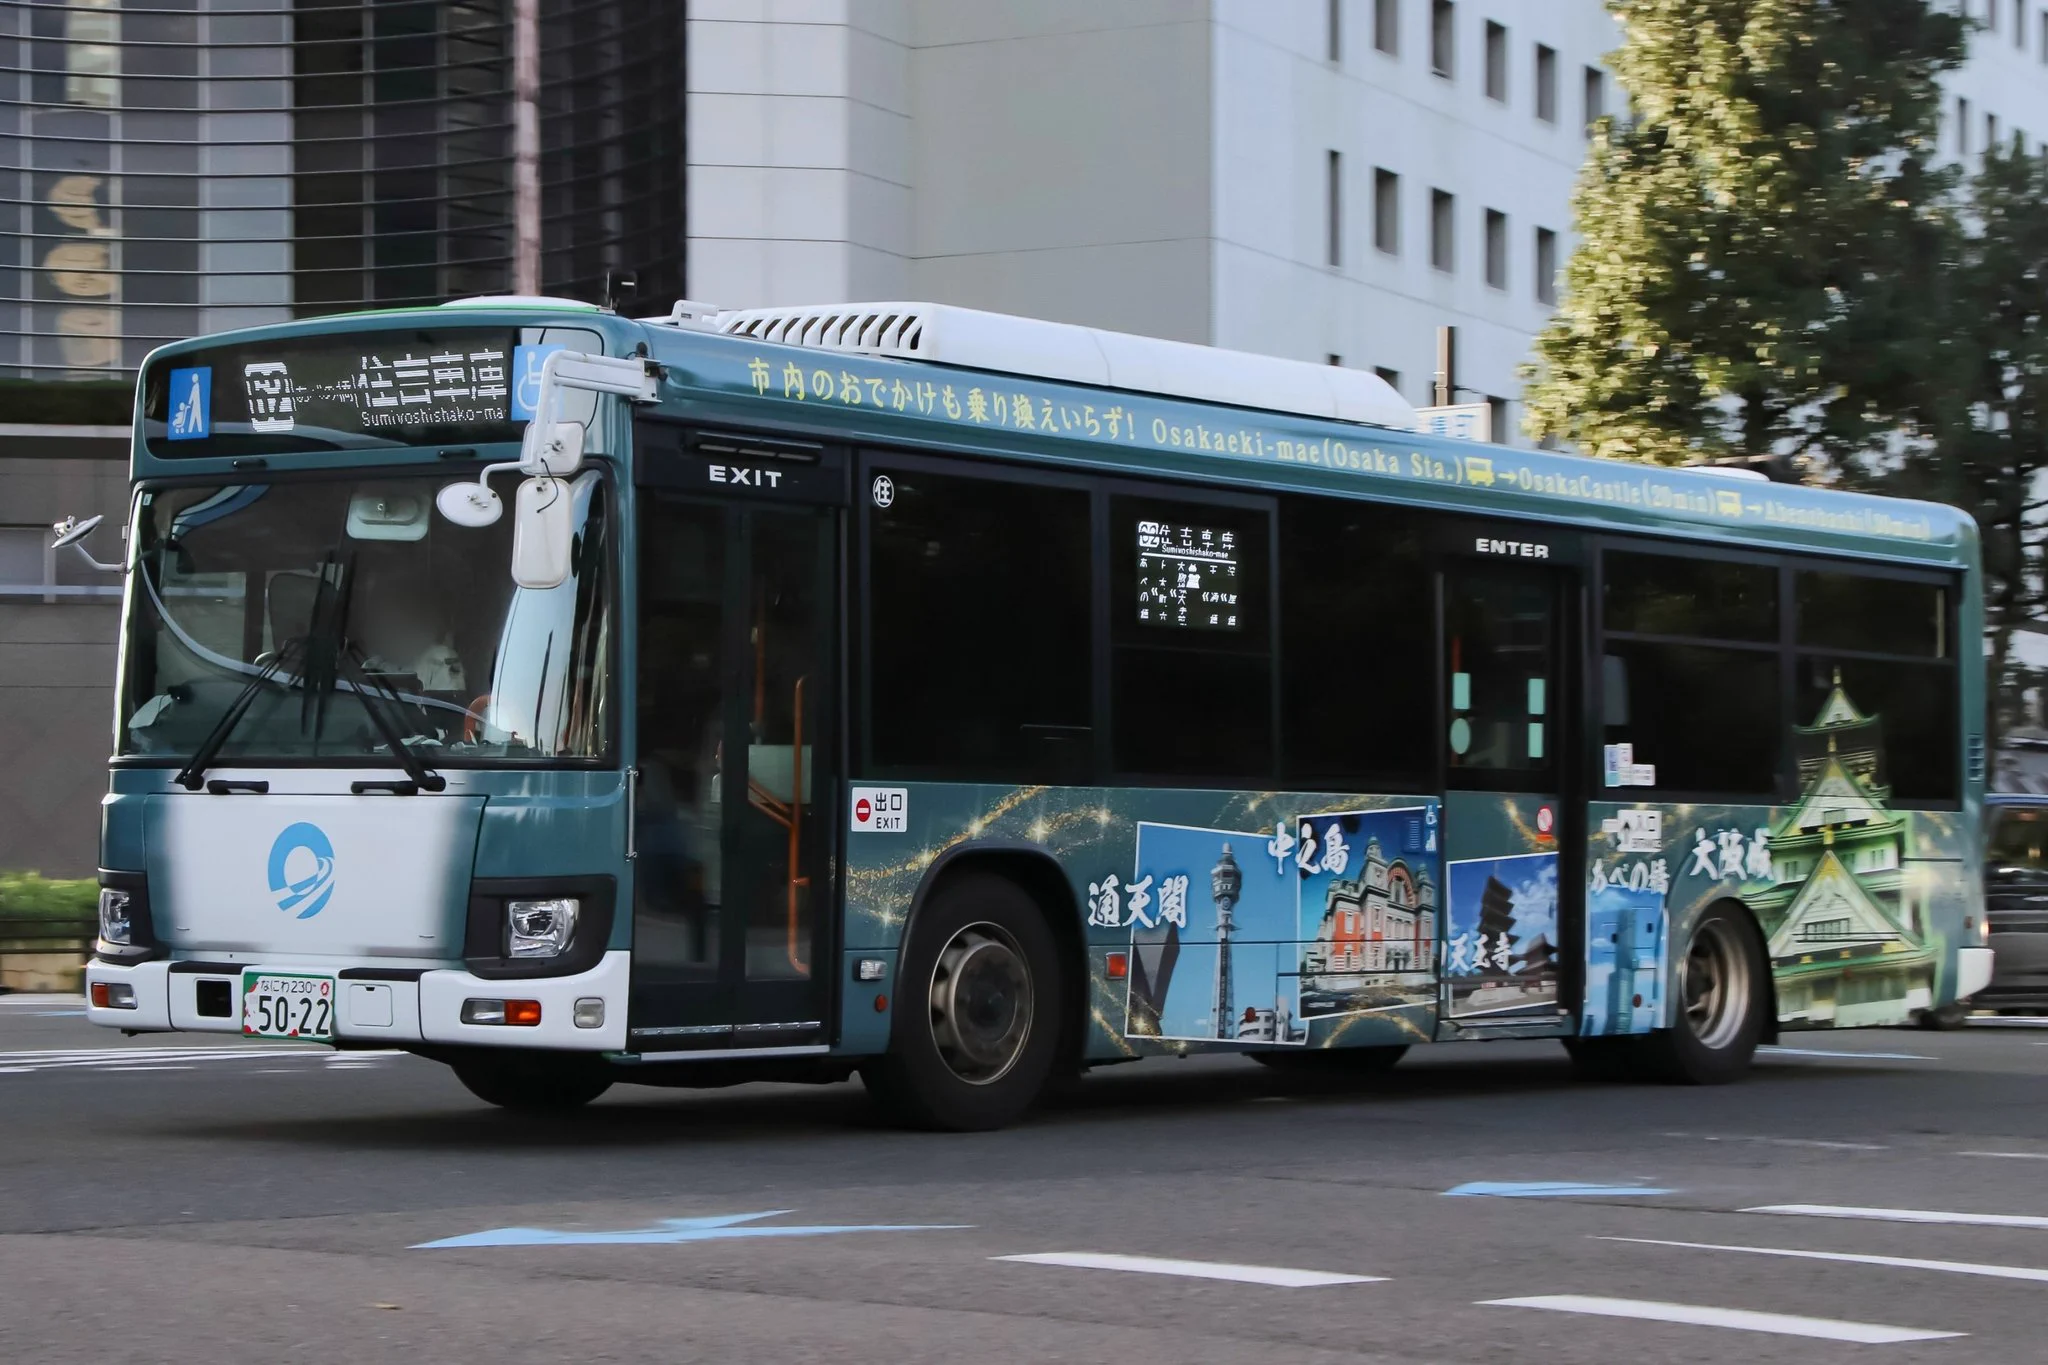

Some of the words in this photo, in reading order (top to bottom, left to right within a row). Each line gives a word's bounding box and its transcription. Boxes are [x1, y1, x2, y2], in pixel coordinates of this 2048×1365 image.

[708, 464, 783, 488] EXIT
[874, 477, 893, 505] 住
[1475, 538, 1549, 559] ENTER
[875, 792, 902, 812] 出口
[876, 817, 901, 829] EXIT
[1267, 822, 1350, 875] 中之島
[1087, 874, 1189, 929] 通天閣
[258, 995, 329, 1035] 50-22
